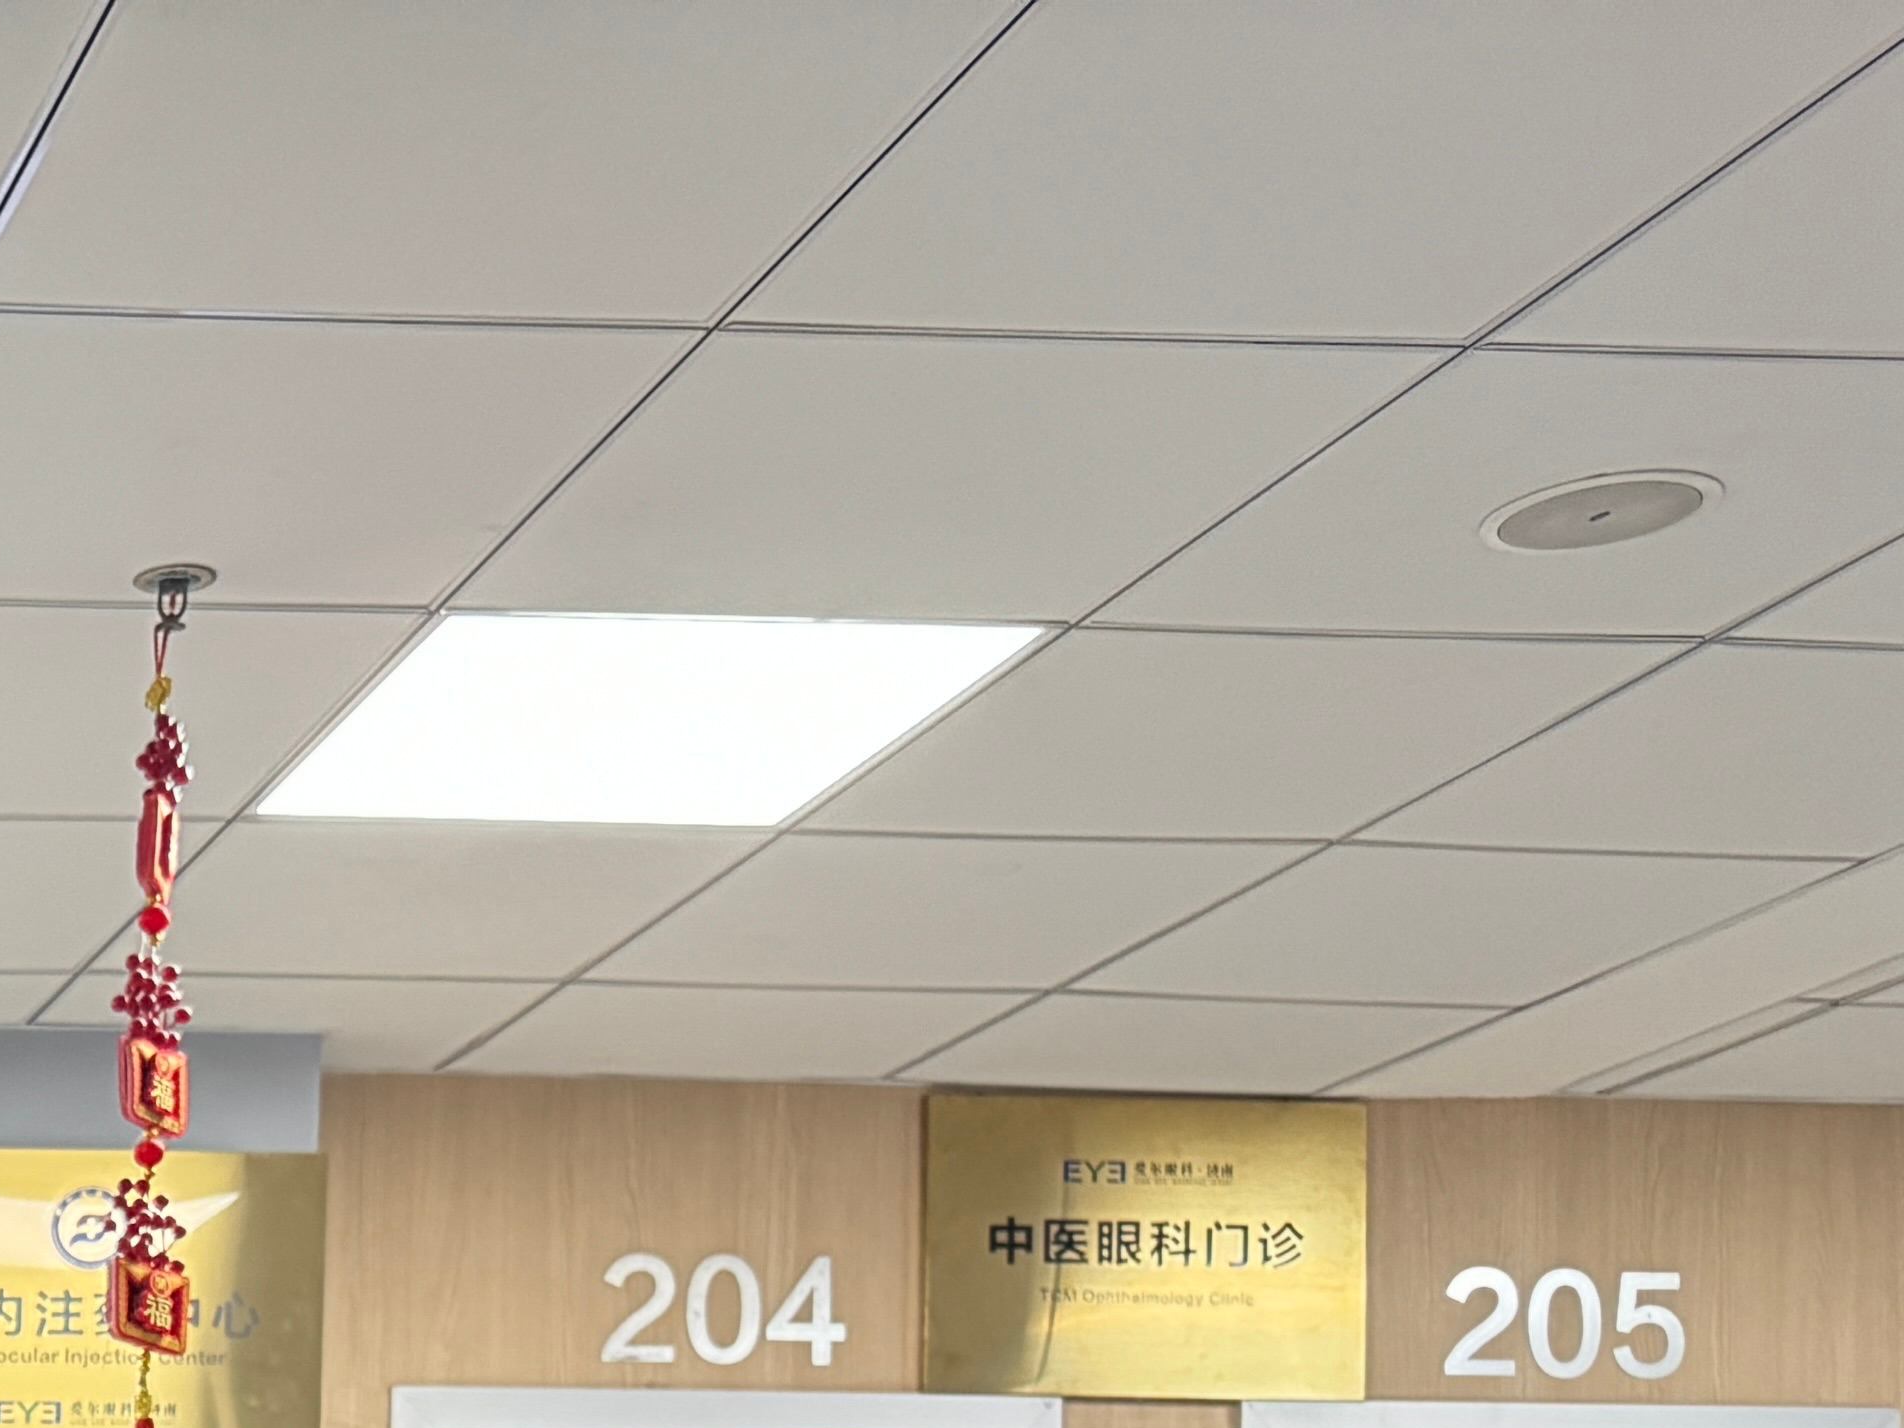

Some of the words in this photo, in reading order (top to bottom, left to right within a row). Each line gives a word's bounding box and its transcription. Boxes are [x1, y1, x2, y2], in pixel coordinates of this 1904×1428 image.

[151, 1077, 174, 1112] 福
[1064, 1160, 1126, 1184] EYE
[989, 1217, 1303, 1268] 中医眼科门诊
[145, 1297, 173, 1331] 福
[601, 1254, 847, 1368] 204
[1040, 1288, 1078, 1304] TCM
[1083, 1288, 1203, 1308] Ophthalmology
[1209, 1290, 1254, 1306] Clinic
[1442, 1266, 1687, 1380] 205
[65, 1347, 142, 1368] Injectio
